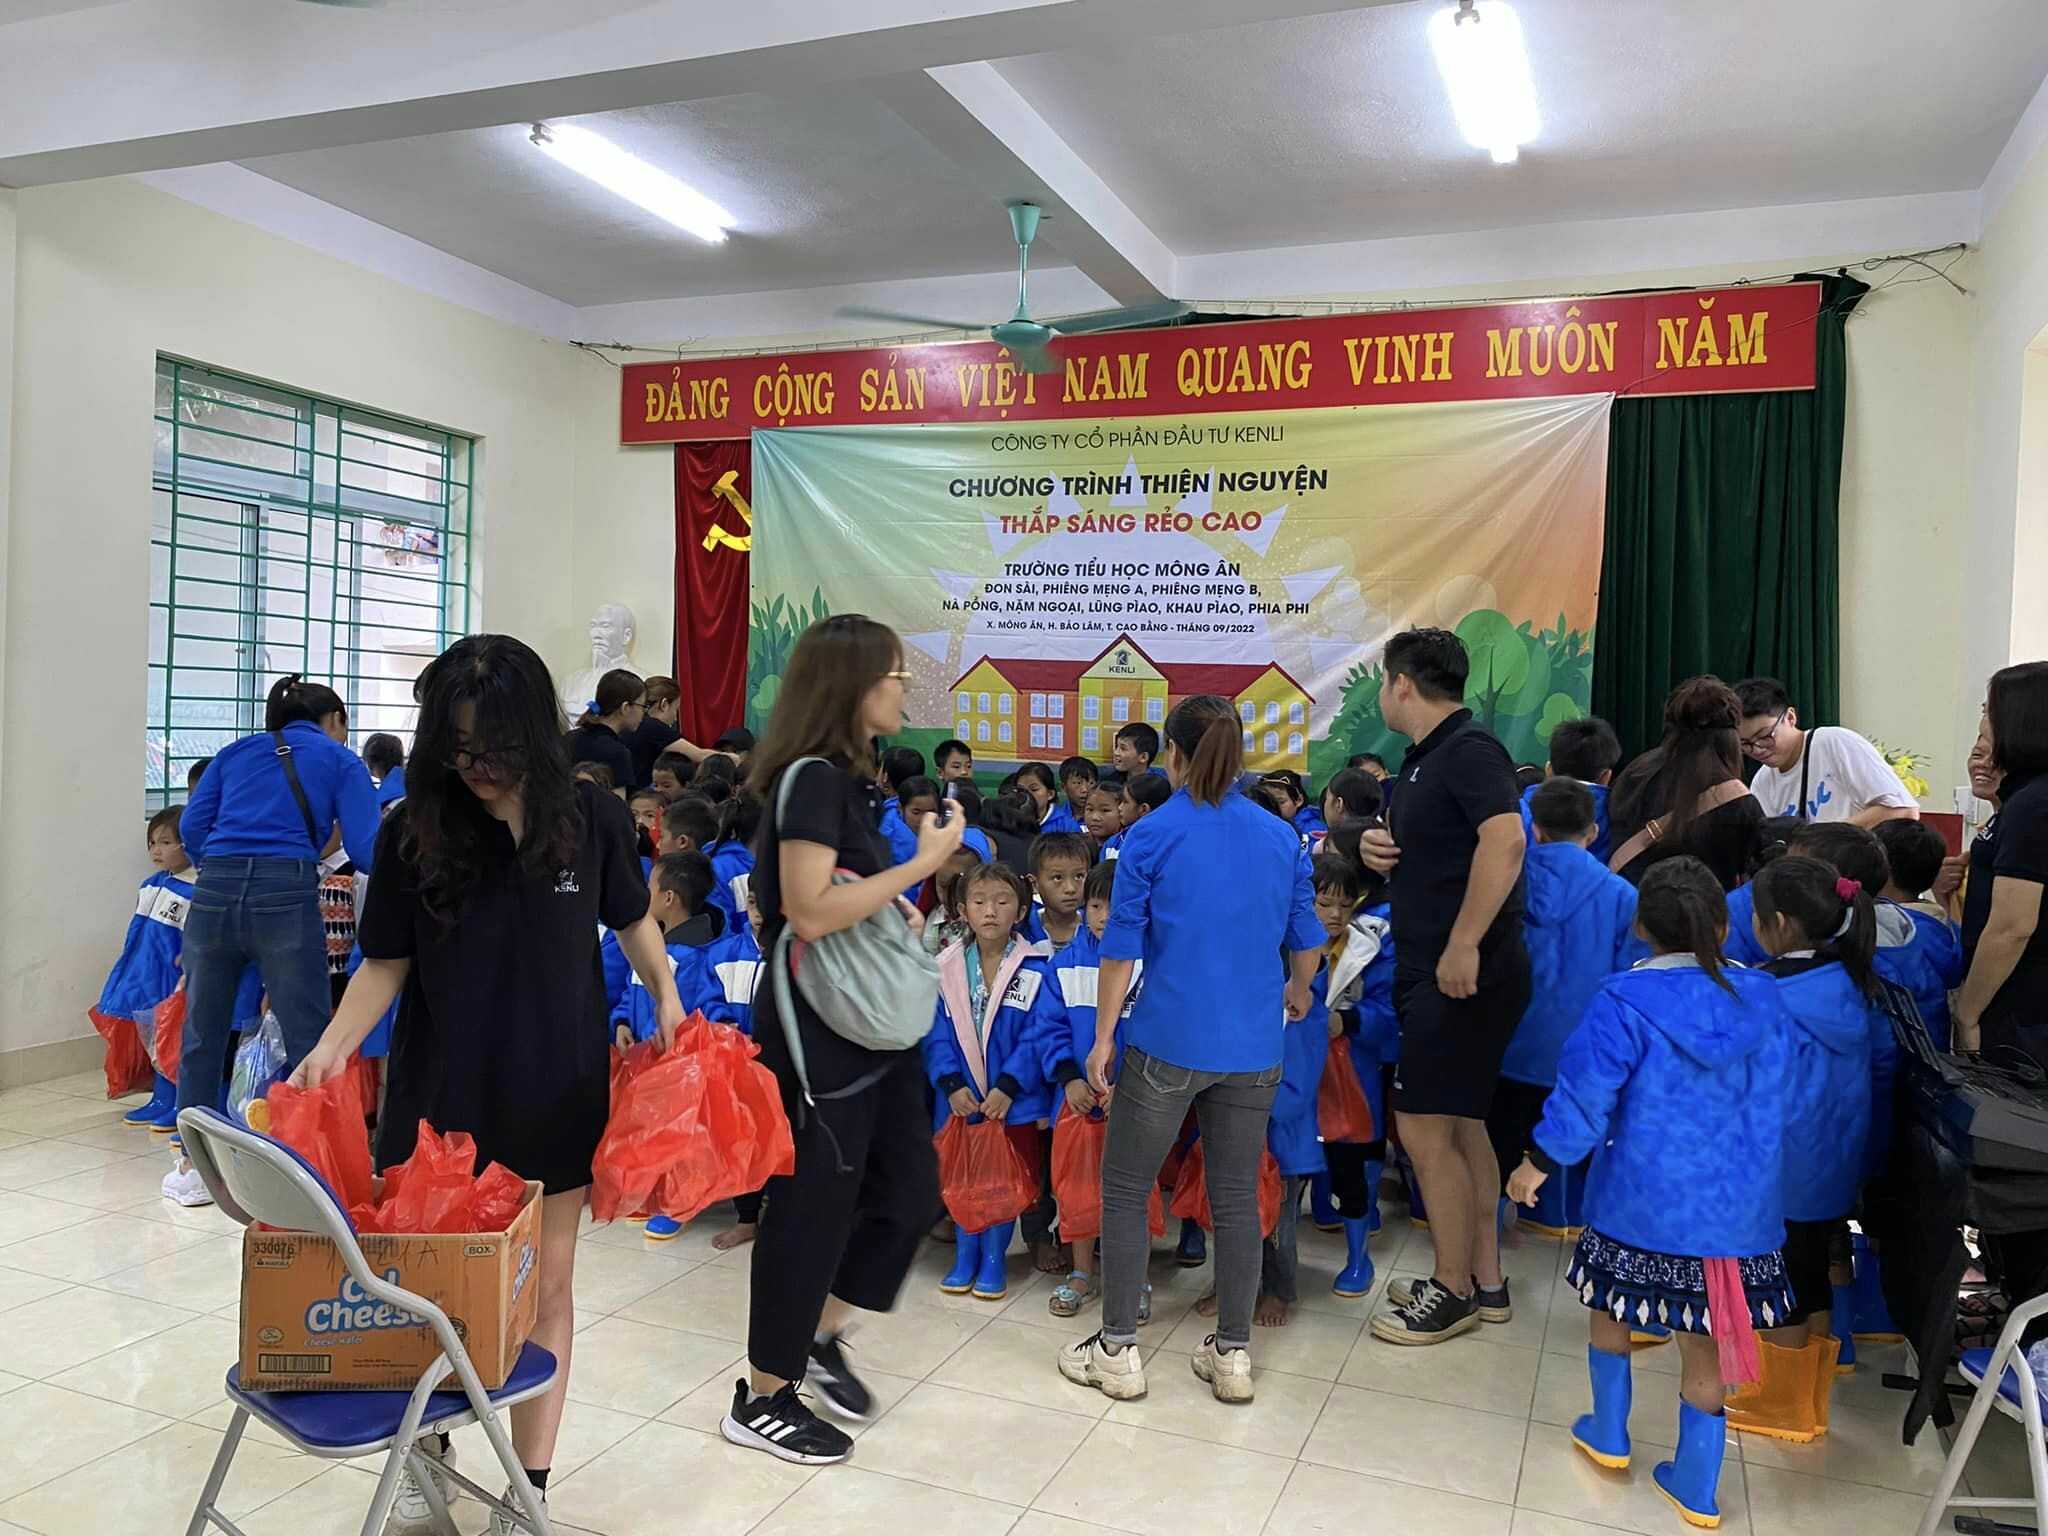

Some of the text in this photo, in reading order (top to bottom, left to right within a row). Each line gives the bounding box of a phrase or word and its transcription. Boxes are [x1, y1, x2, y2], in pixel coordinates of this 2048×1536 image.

[645, 365, 730, 423] ĐẢNG
[753, 363, 835, 427] CỘNG
[859, 352, 927, 413] SẢN
[1062, 353, 1150, 403] NAM
[1177, 339, 1313, 398] QUANG
[1343, 331, 1454, 386] VINH
[1485, 304, 1618, 379] MUÔN
[1656, 296, 1768, 369] NĂM
[991, 424, 1284, 451] CÔNG TY CỔ PHẦN ĐẦU TƯ KENLI
[949, 463, 1328, 499] CHƯƠNG TRÌNH THIỆN NGUYỆN
[1000, 505, 1263, 534] THẮP SÁNG RẺO CAO
[1005, 556, 1241, 580] TRƯỜNG TIỂU HỌC MÔNG ÂN
[984, 583, 1012, 594] ĐON
[1042, 581, 1089, 595] PHIÊNG
[1093, 584, 1131, 597] MẸNG
[1134, 584, 1147, 597] A,
[1151, 581, 1201, 595] PHIÊNG
[1205, 584, 1245, 598] MẸNG
[1249, 584, 1262, 597] B,
[1038, 601, 1084, 615] NGOẠI,
[1088, 599, 1123, 613] LŨNG
[1166, 602, 1203, 614] KHAU
[1248, 603, 1281, 614] PHIA
[1286, 603, 1309, 614] PHI
[998, 620, 1027, 630] MÔNG
[1116, 623, 1138, 632] CAO
[1176, 621, 1210, 633] THÁNG
[1213, 624, 1255, 634] 09/2022
[1108, 665, 1136, 673] KENLI
[1002, 991, 1026, 1003] ENLI
[468, 1245, 492, 1255] BOX
